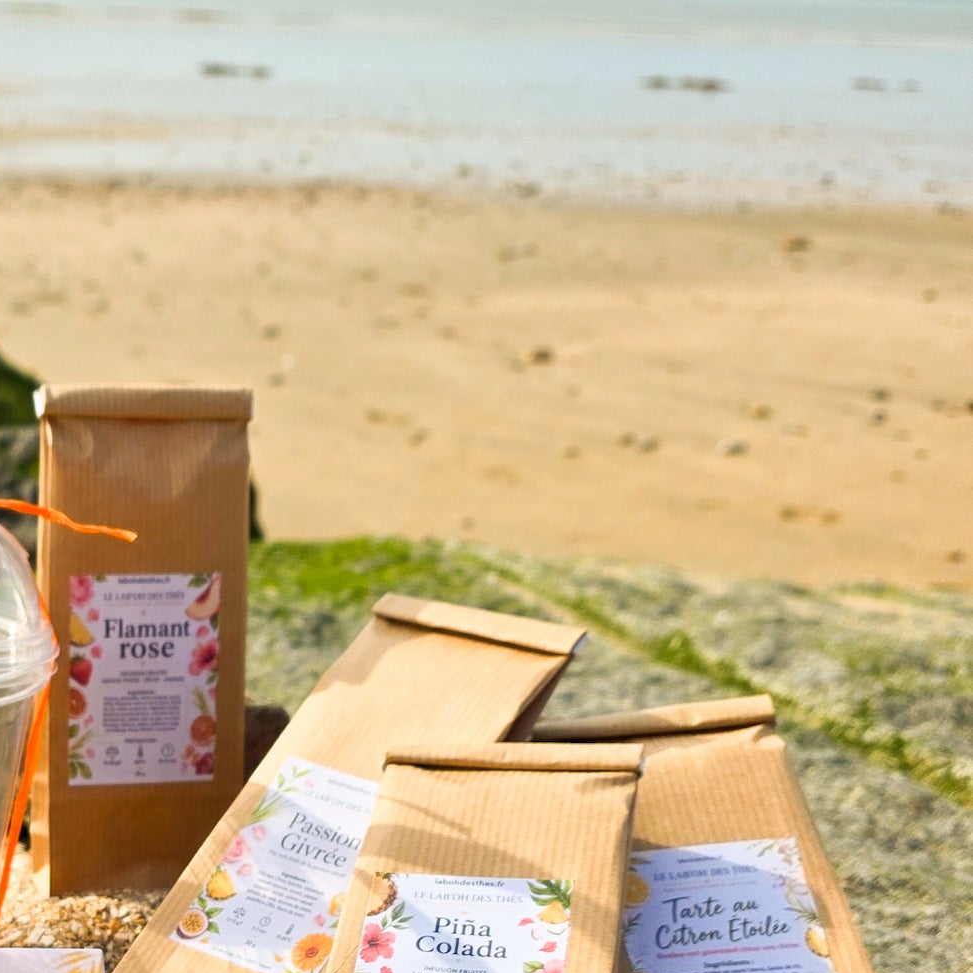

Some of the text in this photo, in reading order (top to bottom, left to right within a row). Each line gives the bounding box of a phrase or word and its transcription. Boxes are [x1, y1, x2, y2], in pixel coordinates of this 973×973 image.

[104, 618, 190, 638] Flamant
[120, 641, 175, 659] rose
[289, 812, 362, 850] Passion
[281, 832, 347, 867] Givrée
[435, 878, 505, 887] labohdesthes.fr
[430, 892, 469, 901] LAB'OH
[661, 896, 758, 923] Tarte au
[433, 916, 491, 937] Piña
[655, 914, 790, 950] Citron Étoilée
[416, 935, 507, 958] Colada
